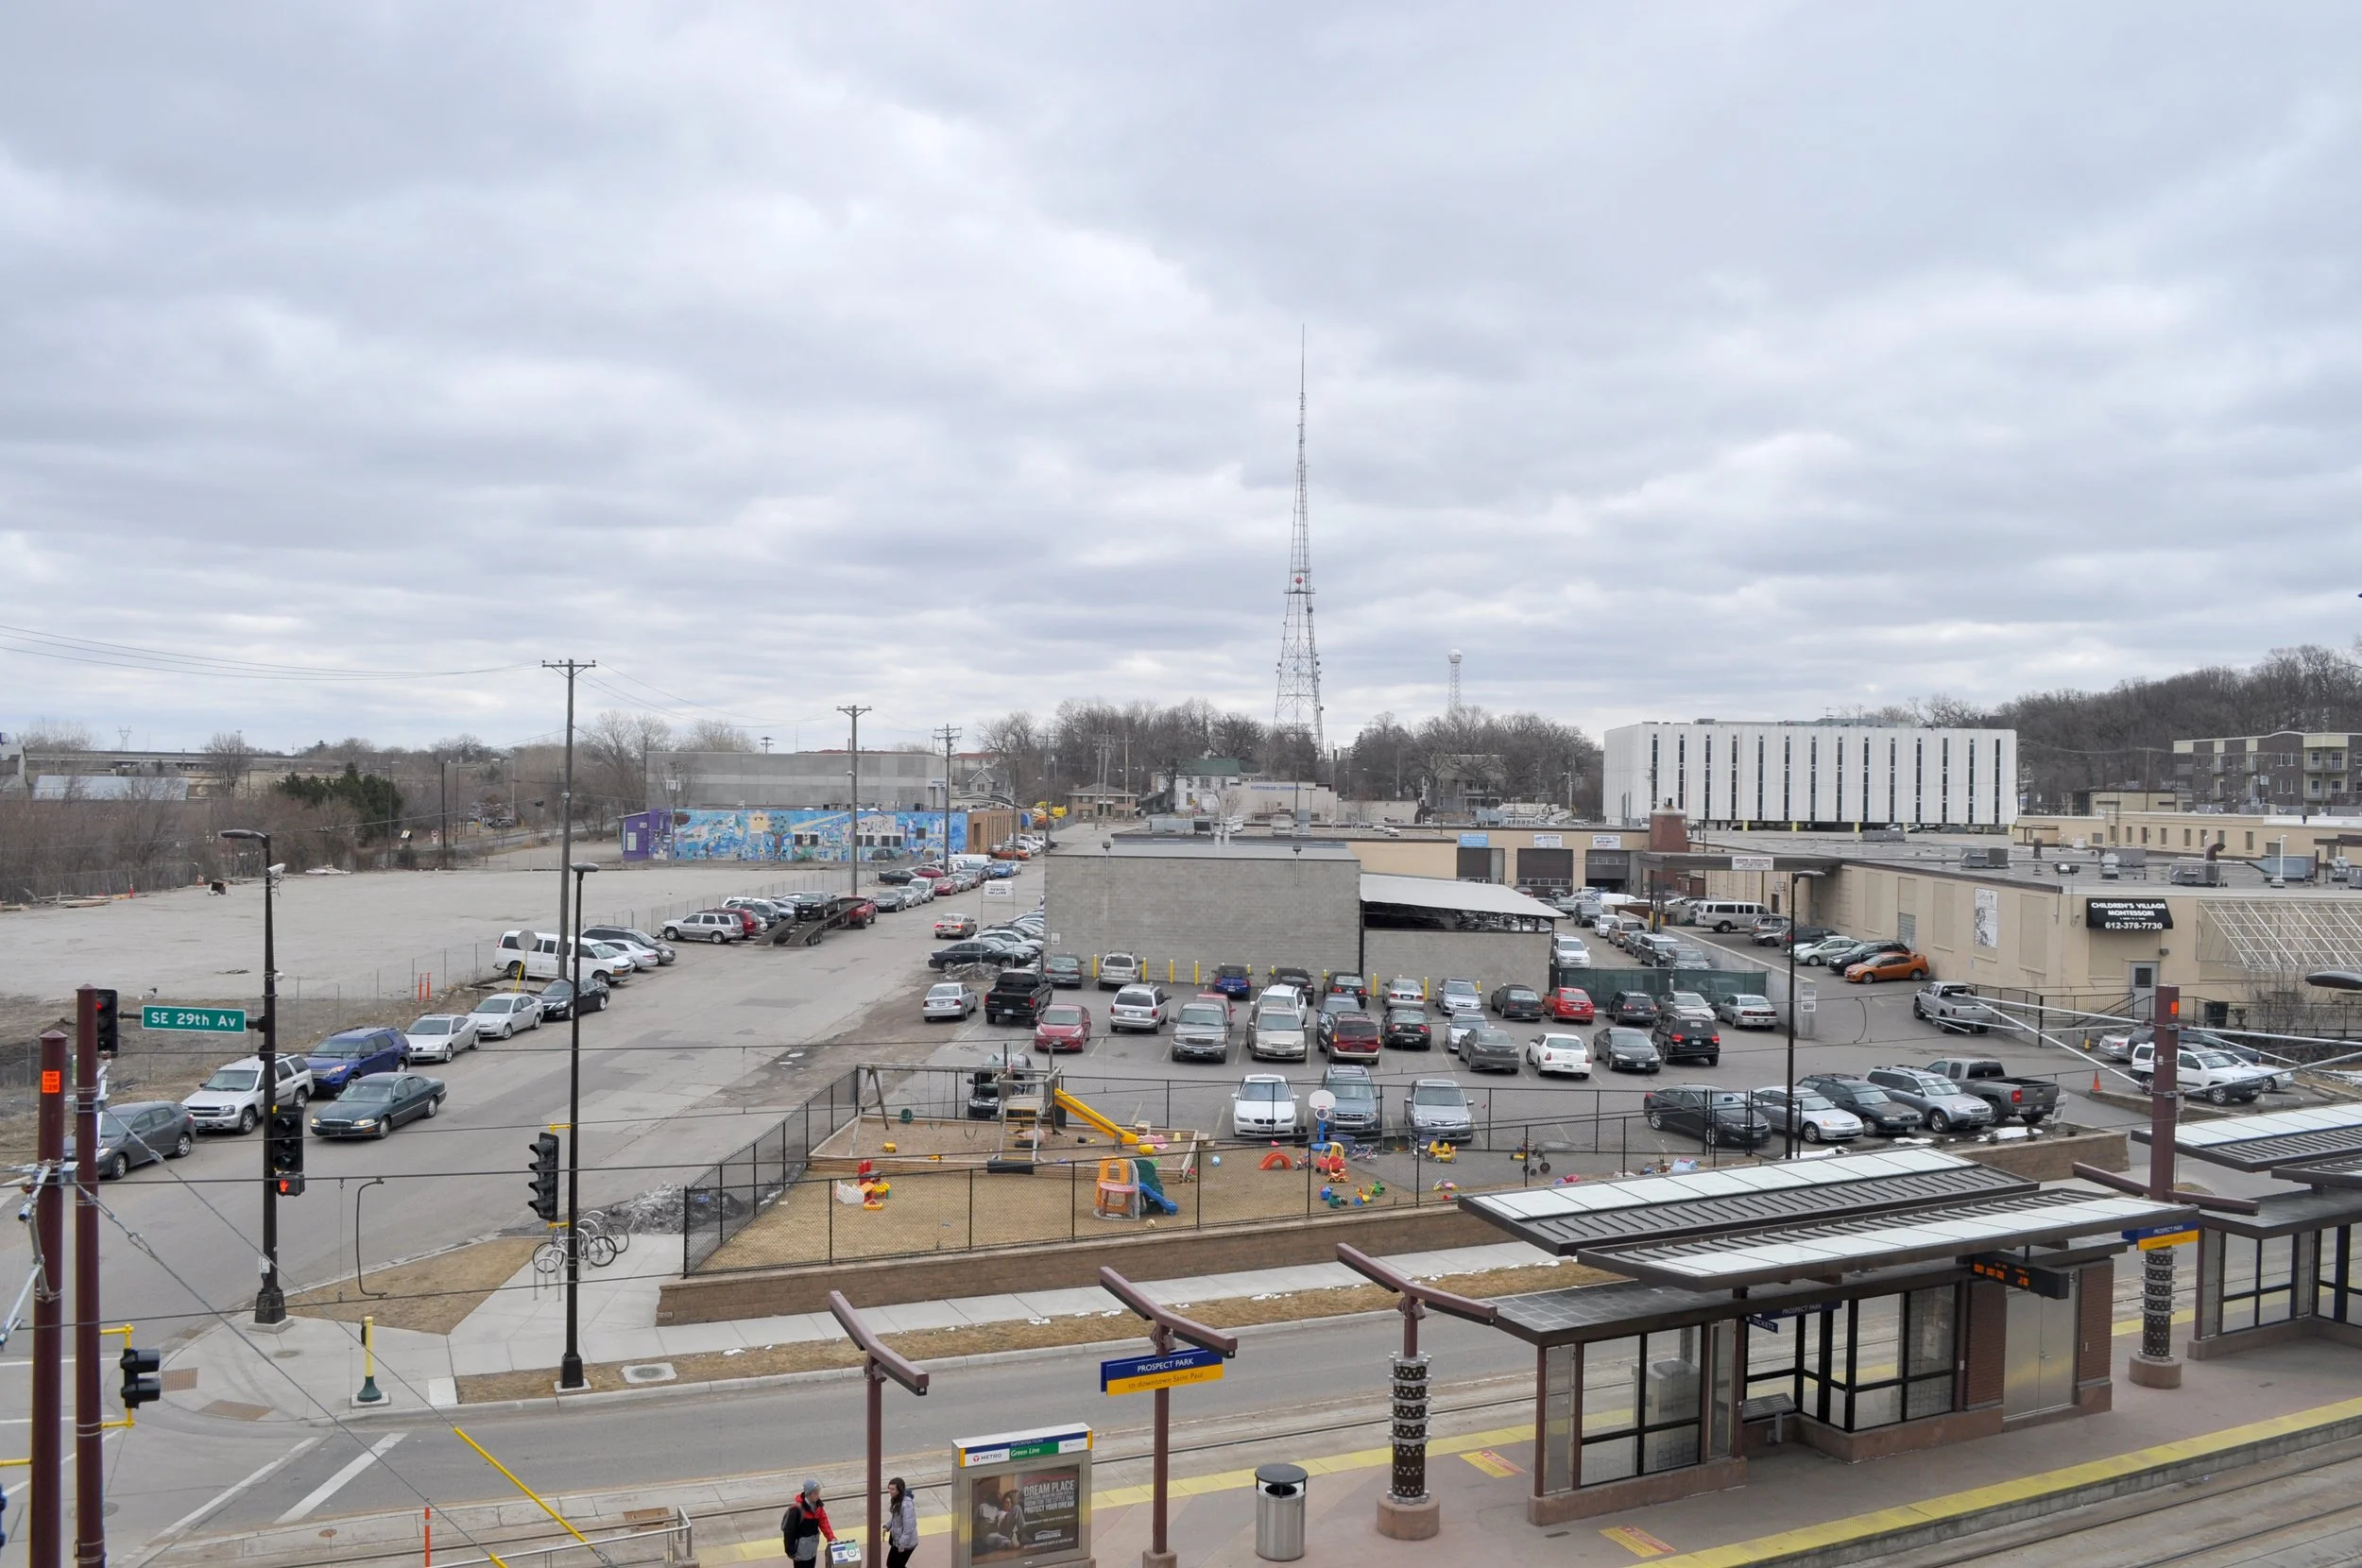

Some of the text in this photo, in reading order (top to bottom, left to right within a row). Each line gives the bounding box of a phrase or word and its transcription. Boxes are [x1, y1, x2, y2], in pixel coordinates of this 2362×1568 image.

[2105, 921, 2163, 929] 612-378-7730
[151, 1012, 236, 1027] SE 29th Av
[1782, 1305, 1807, 1315] PROSPECT
[1754, 1317, 1774, 1330] TICKETS
[1137, 1357, 1193, 1372] PROSPECT PARK
[1138, 1377, 1172, 1388] downtown
[1173, 1374, 1189, 1383] Saint
[1010, 1438, 1043, 1447] INFORMATION
[1011, 1448, 1028, 1457] Green
[1024, 1483, 1050, 1496] DREAM
[1052, 1480, 1074, 1491] PLACE
[1024, 1505, 1044, 1513] PROTECT
[1058, 1499, 1074, 1508] DREAM
